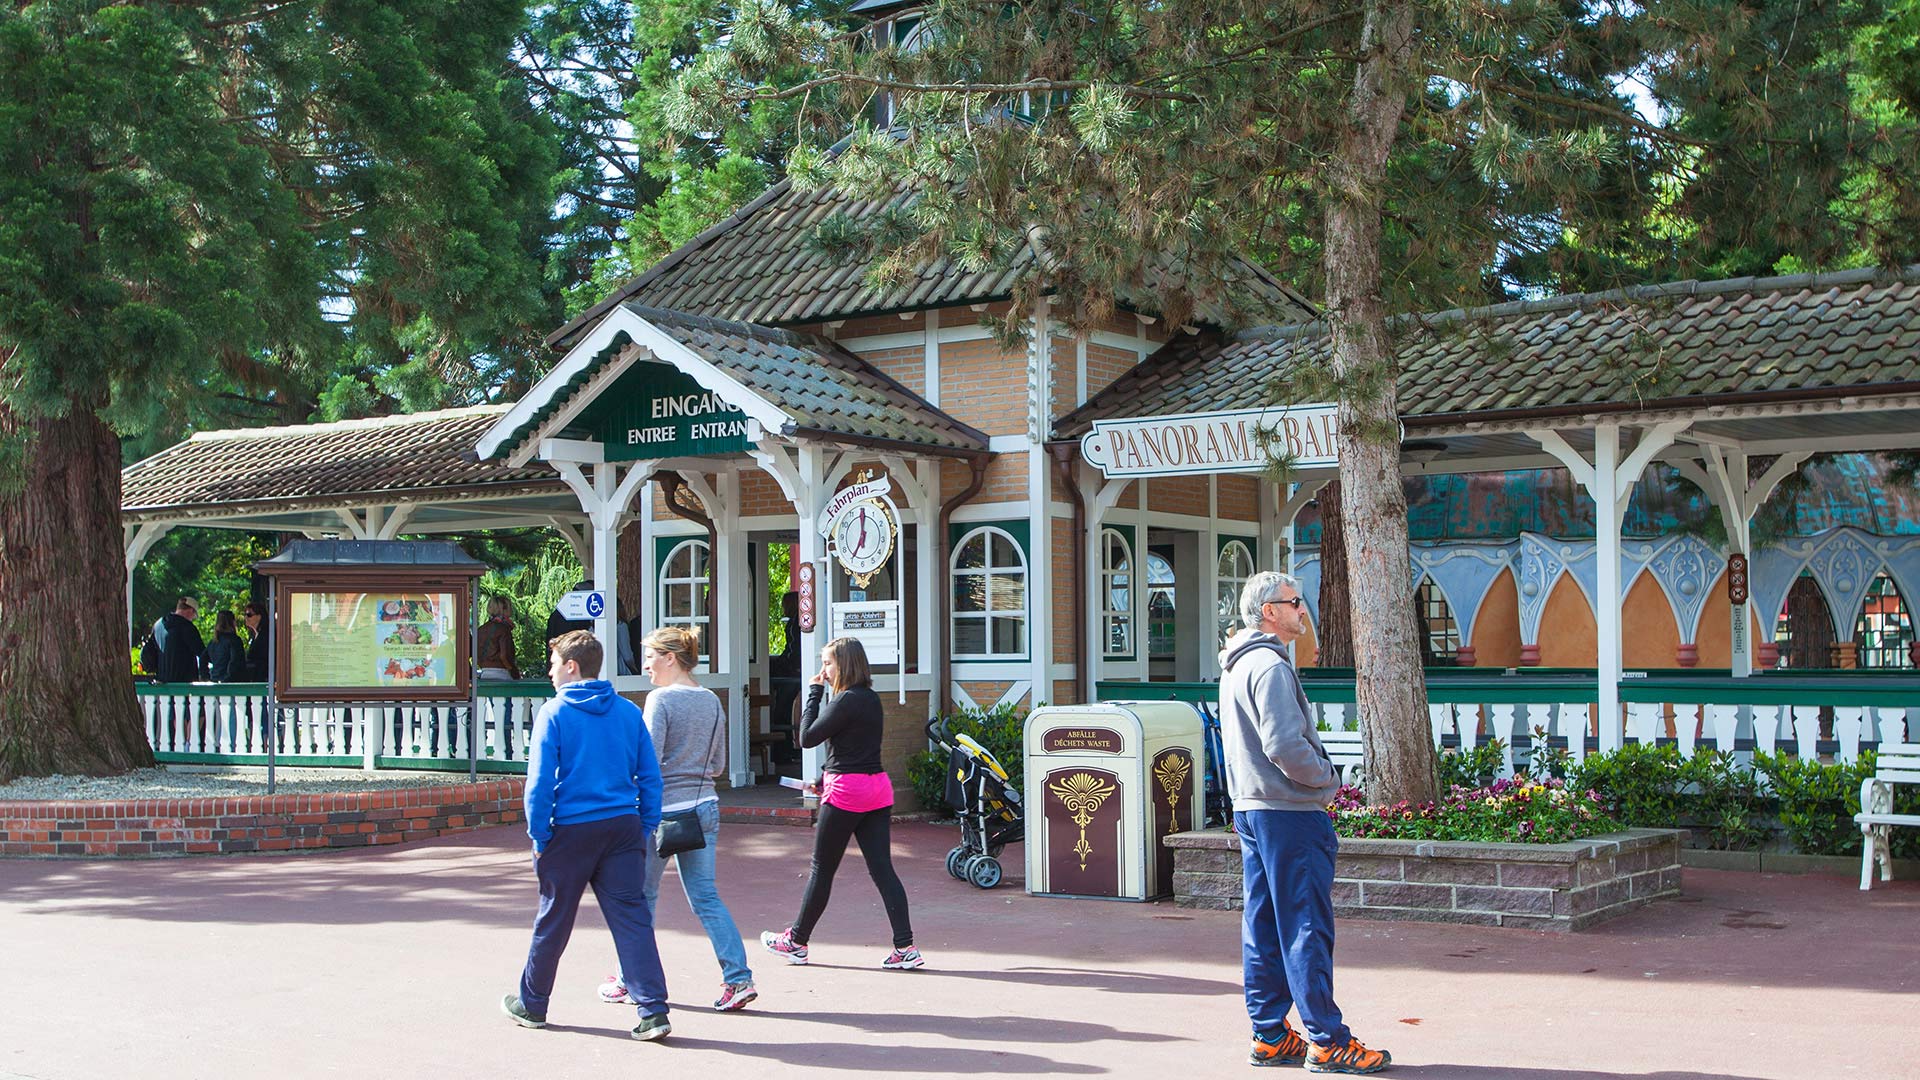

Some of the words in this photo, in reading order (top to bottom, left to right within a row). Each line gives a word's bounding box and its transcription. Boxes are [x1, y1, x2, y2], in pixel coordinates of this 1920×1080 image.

[628, 425, 676, 445] ENTREE
[827, 484, 869, 519] Fahrplan
[1067, 730, 1096, 738] ABFÄLLE
[1054, 739, 1085, 748] DÉCHETS
[1087, 740, 1111, 748] WASTE
